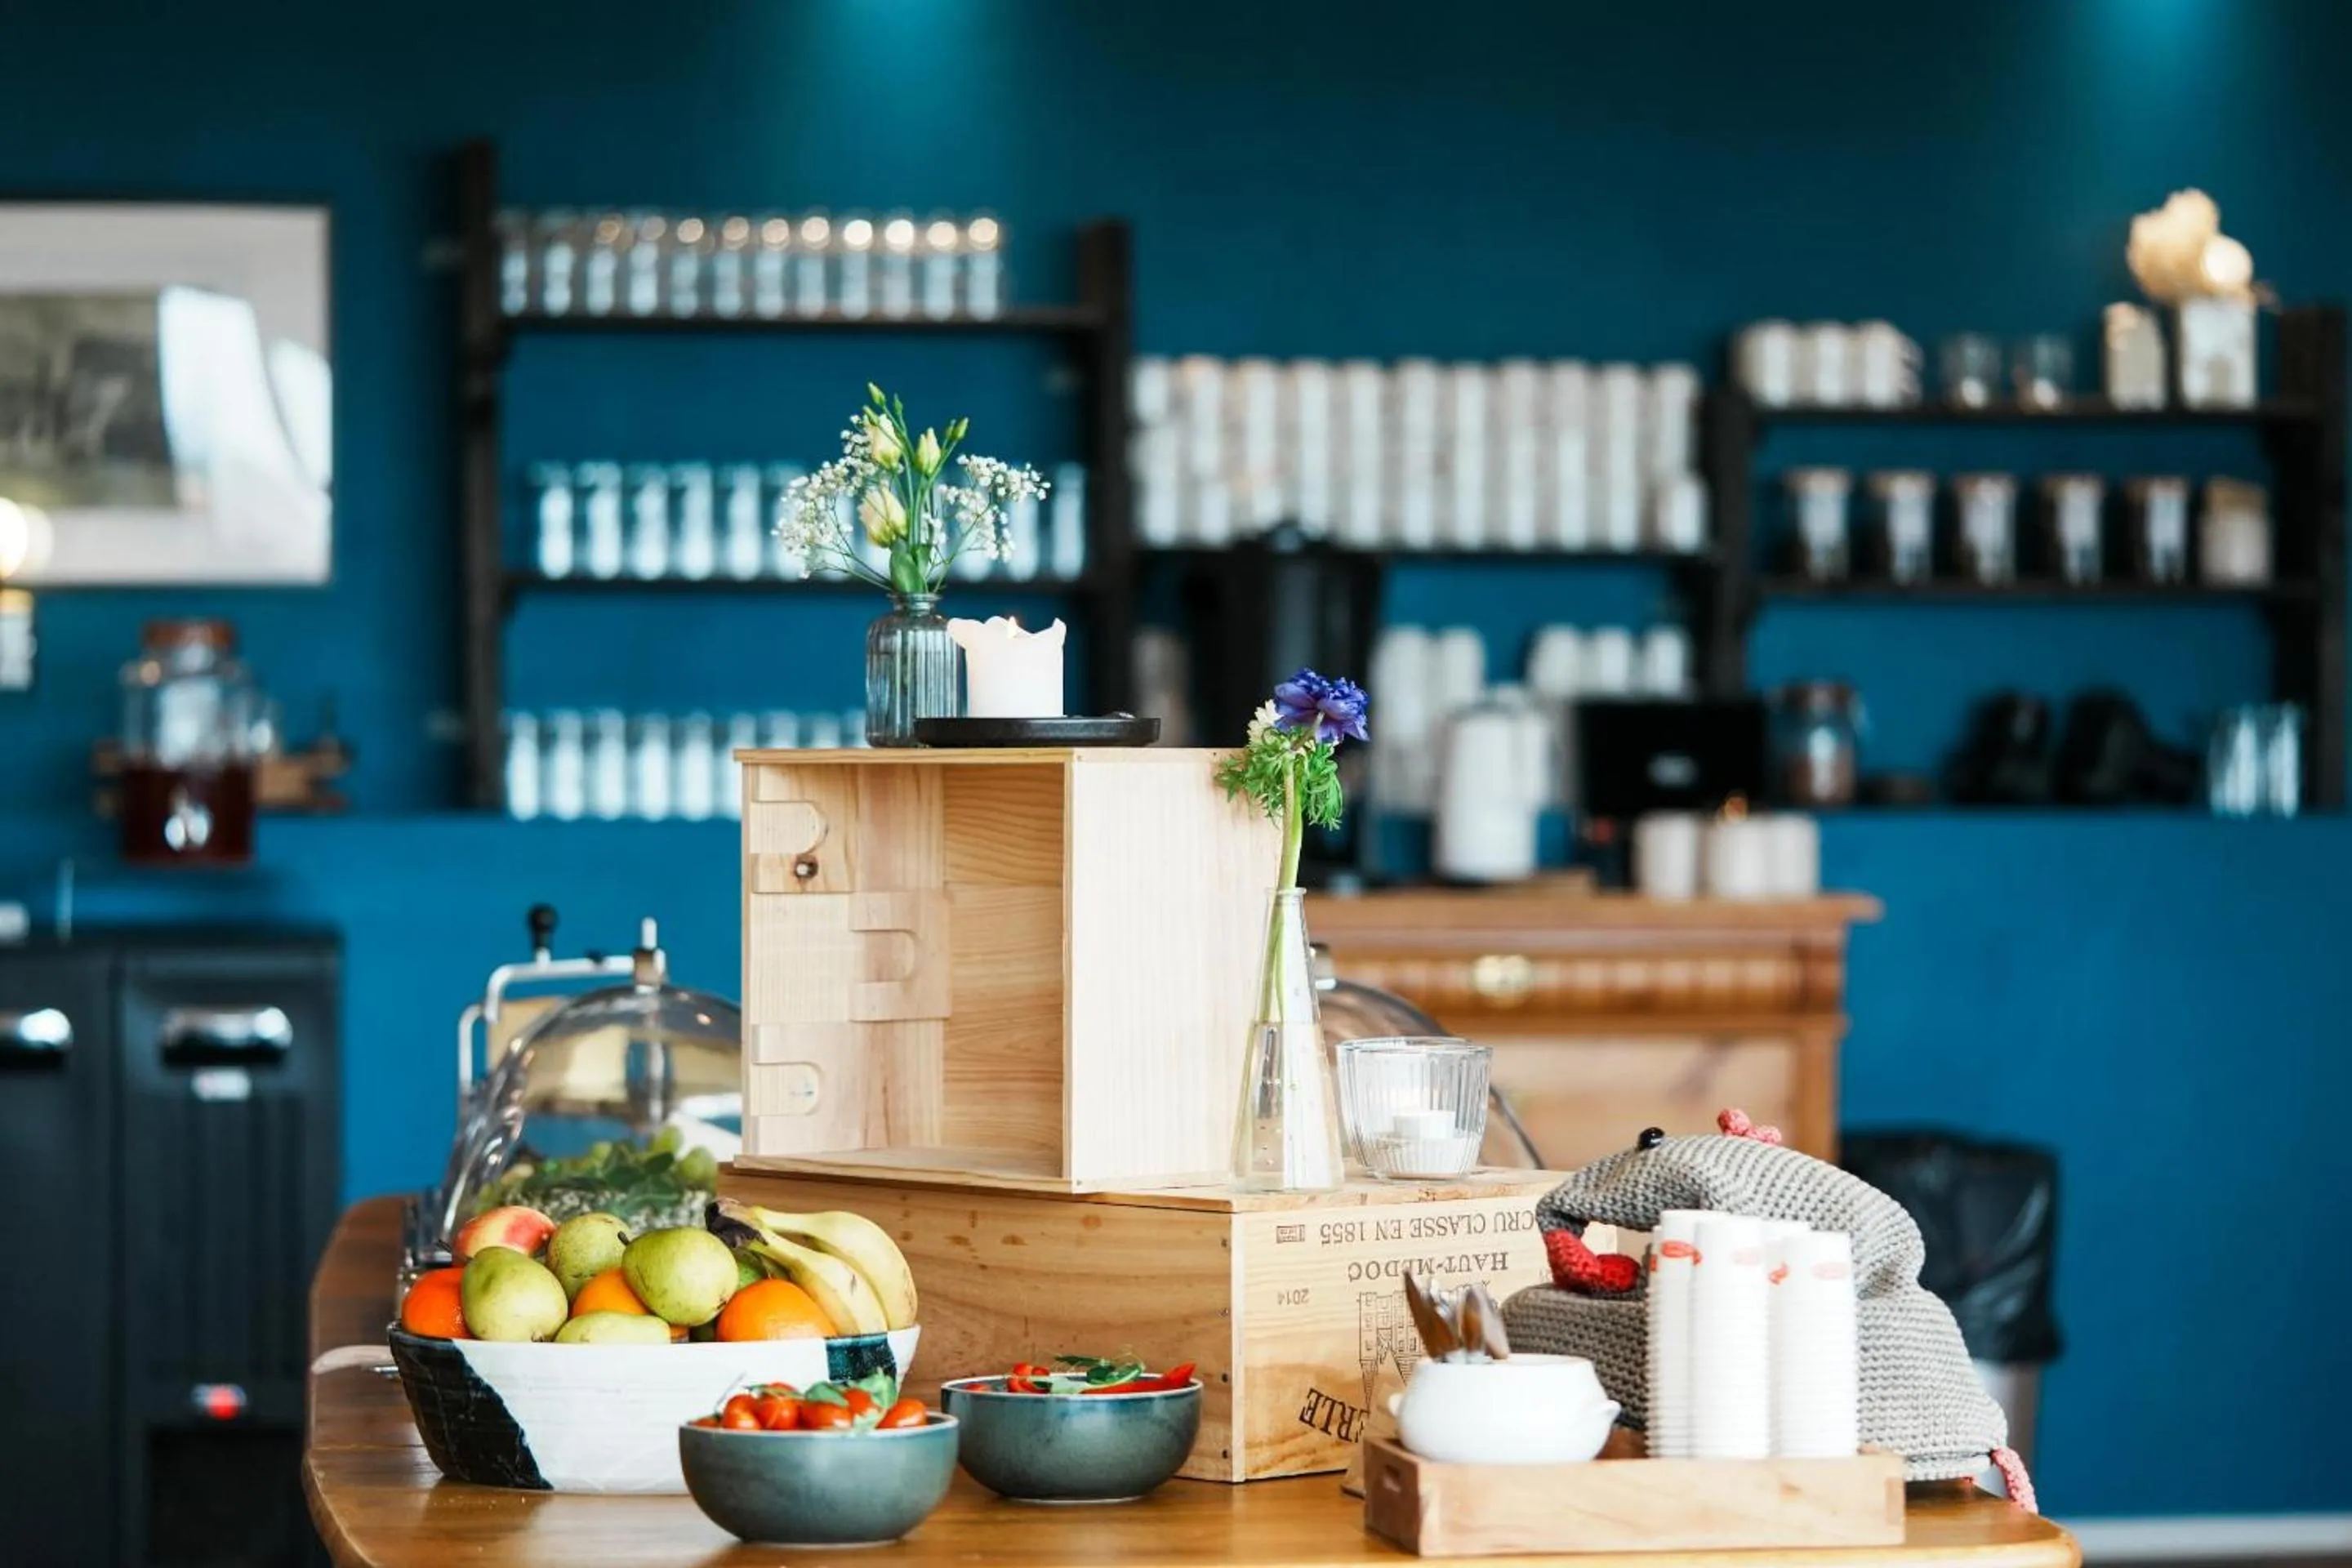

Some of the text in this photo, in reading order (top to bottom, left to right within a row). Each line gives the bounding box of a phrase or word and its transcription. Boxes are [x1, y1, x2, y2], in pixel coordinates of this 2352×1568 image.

[1375, 1219, 1401, 1241] EN
[1410, 1213, 1486, 1238] CLASSE
[1493, 1210, 1534, 1232] CRU
[1320, 1221, 1365, 1245] 1855
[1277, 1288, 1309, 1305] 2014
